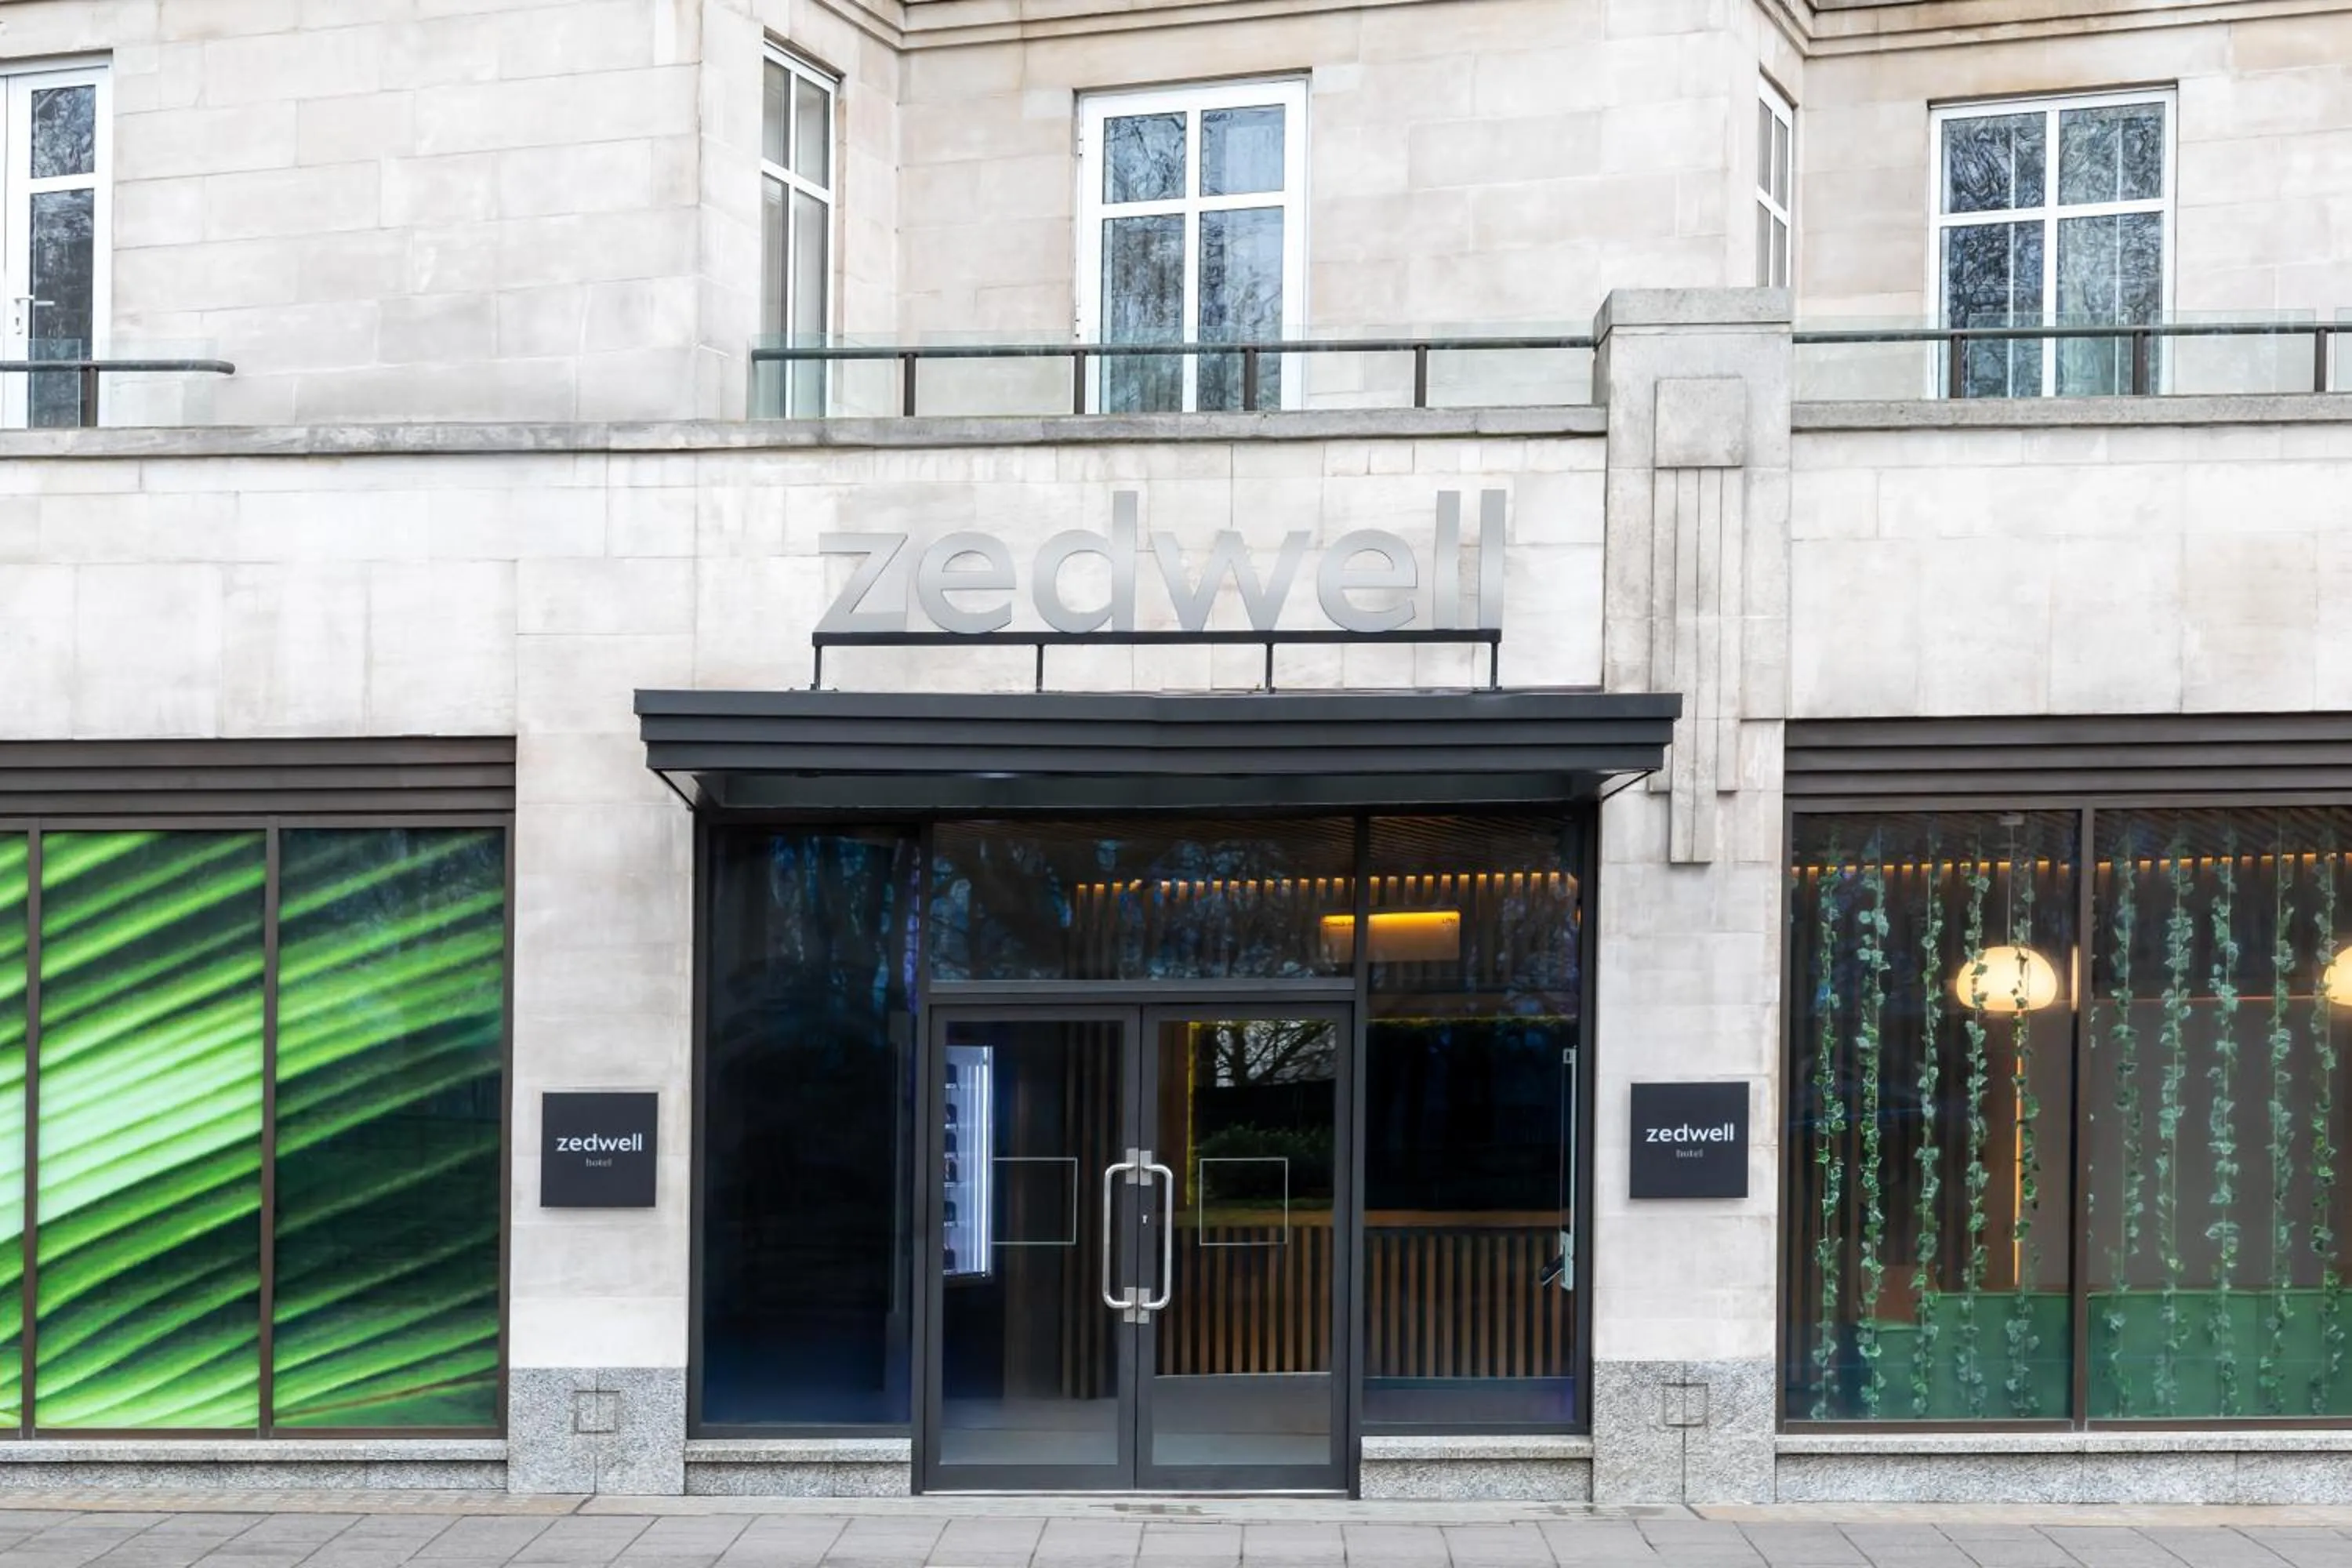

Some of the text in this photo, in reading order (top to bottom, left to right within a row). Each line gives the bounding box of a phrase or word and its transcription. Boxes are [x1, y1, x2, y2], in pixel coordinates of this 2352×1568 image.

[814, 489, 1506, 633] zedwell
[556, 1132, 643, 1152] zedwell
[1646, 1122, 1735, 1142] zedwell
